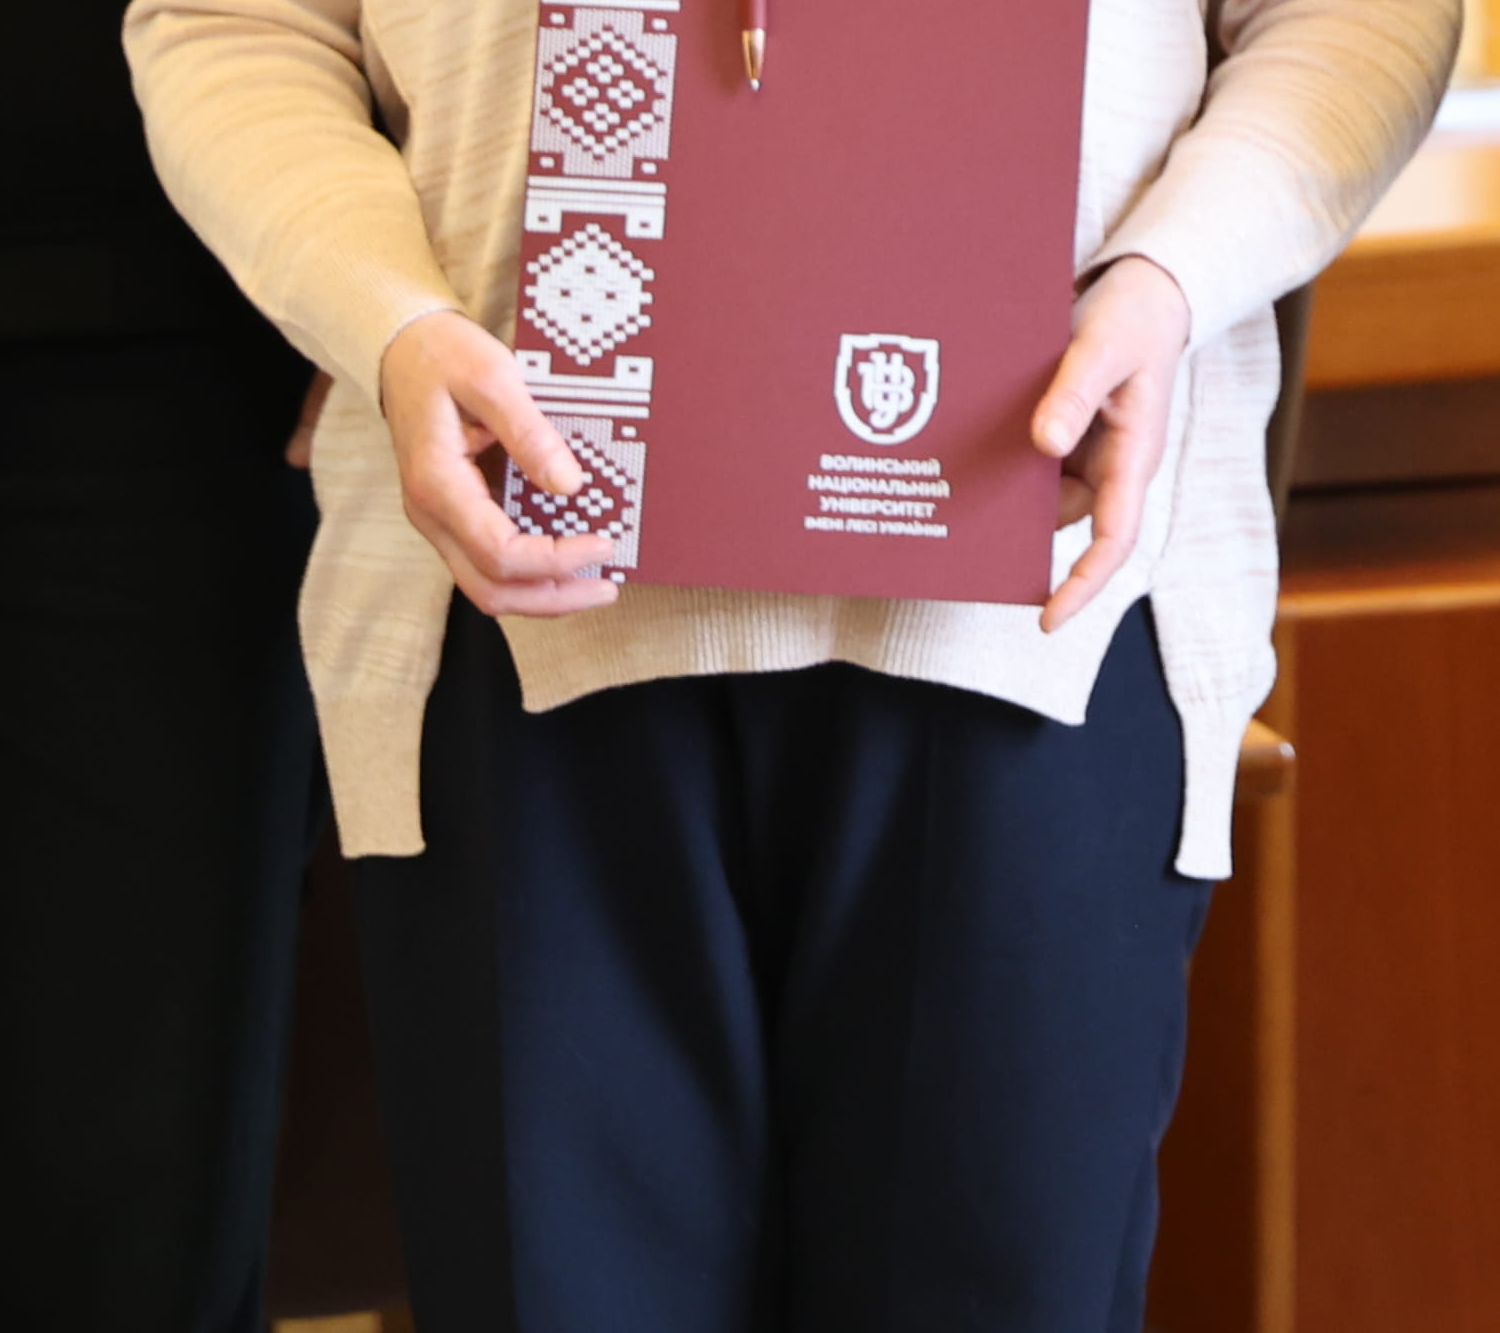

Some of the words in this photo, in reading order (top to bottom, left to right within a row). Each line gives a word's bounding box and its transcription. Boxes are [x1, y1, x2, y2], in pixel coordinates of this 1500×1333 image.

[820, 454, 941, 477] ВОЛИНСЬКИЙ
[808, 474, 950, 498] НАЦІОНАЛЬНИЙ
[819, 495, 936, 519] УНІВЕРСИТЕТ
[804, 516, 844, 531] ІМЕНІ
[845, 518, 878, 534] ЛЕСІ
[879, 519, 948, 538] УКРАЇНИ
